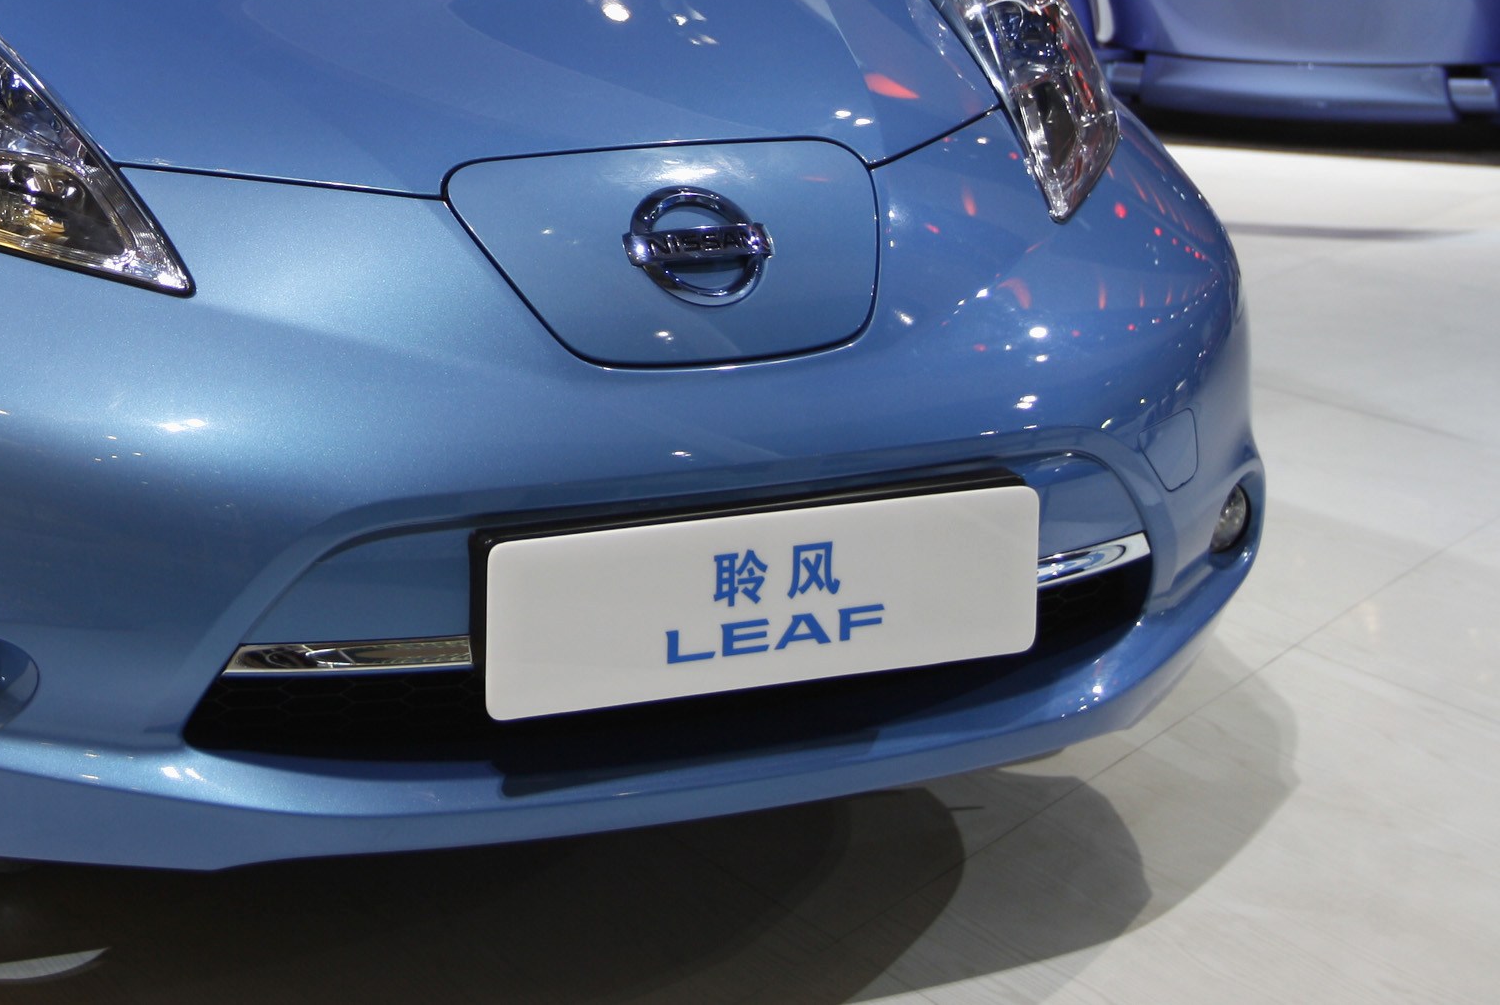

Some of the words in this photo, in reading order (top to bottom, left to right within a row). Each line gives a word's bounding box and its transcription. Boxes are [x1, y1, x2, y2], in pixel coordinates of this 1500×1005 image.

[647, 230, 760, 257] NISSAN
[713, 541, 841, 607] 聆风
[665, 603, 885, 664] LEAF
